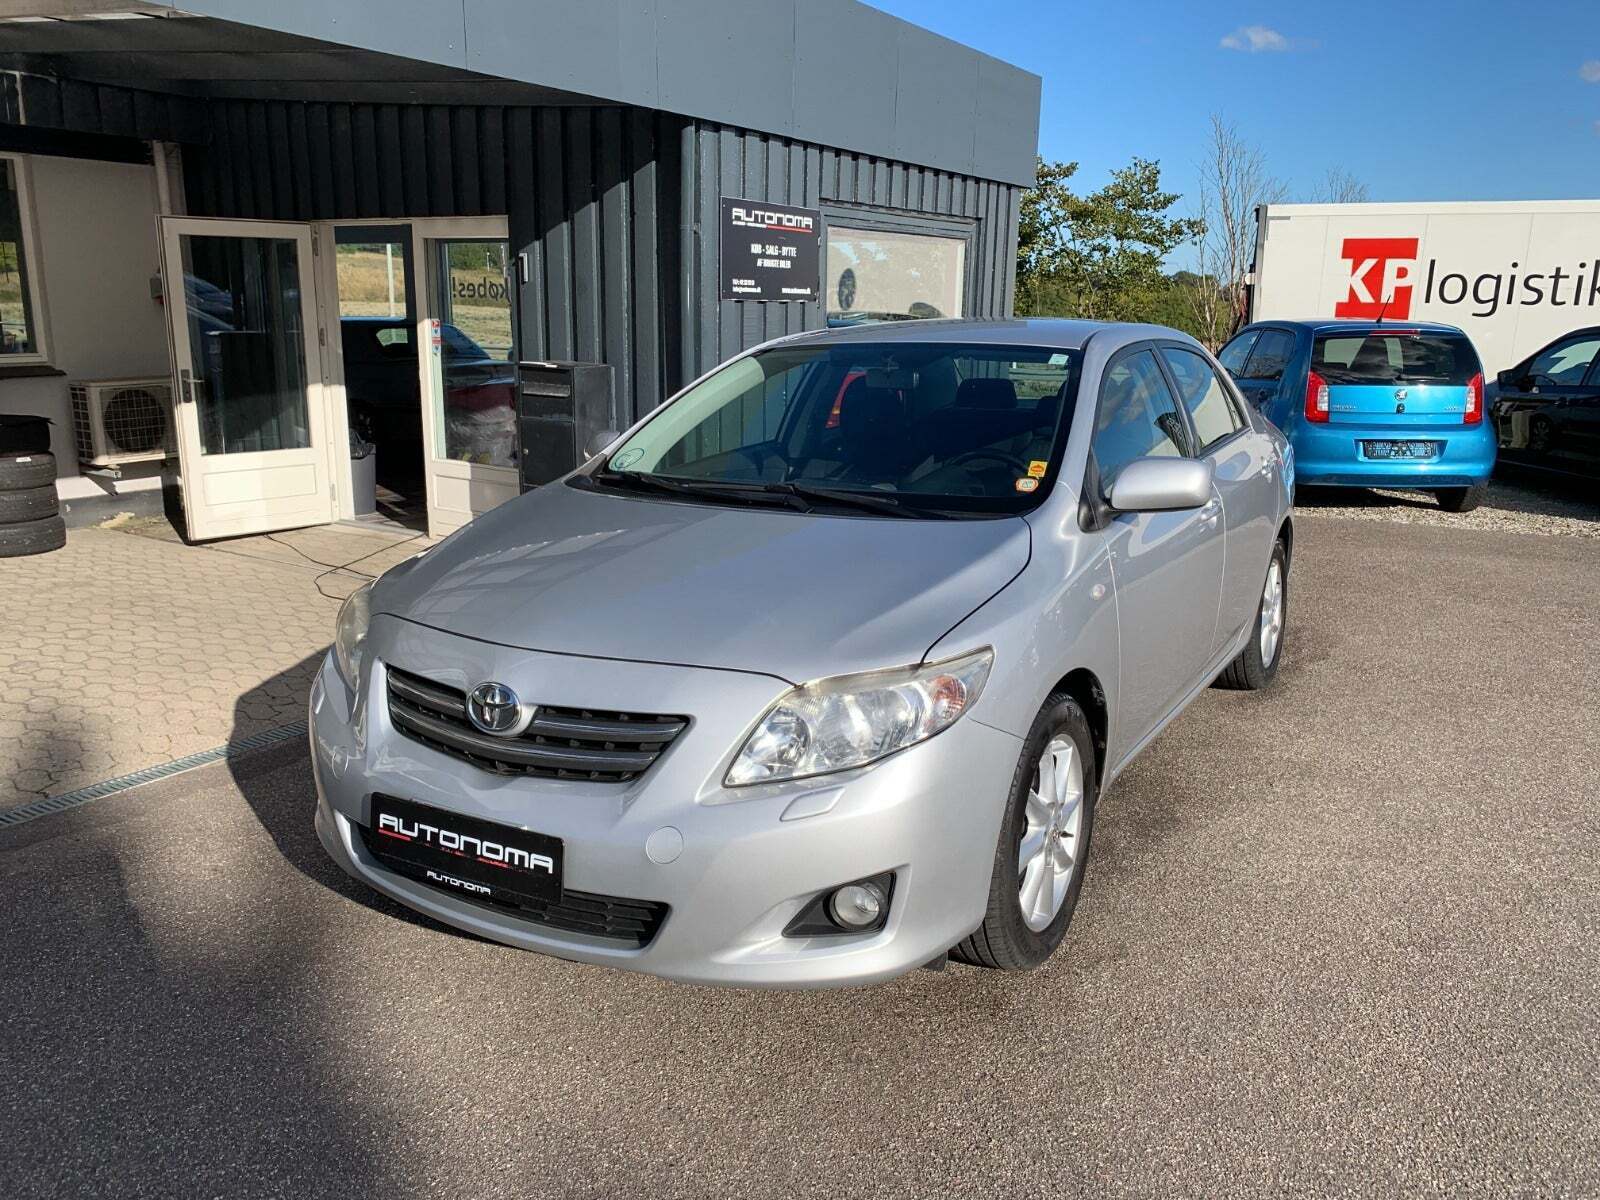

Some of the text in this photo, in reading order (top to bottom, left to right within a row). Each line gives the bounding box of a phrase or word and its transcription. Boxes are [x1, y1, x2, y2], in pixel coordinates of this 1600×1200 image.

[732, 207, 813, 229] AUTONOMA
[1342, 258, 1416, 304] KP
[379, 813, 554, 874] AUTONOMA
[426, 870, 491, 895] AUTONOMA
